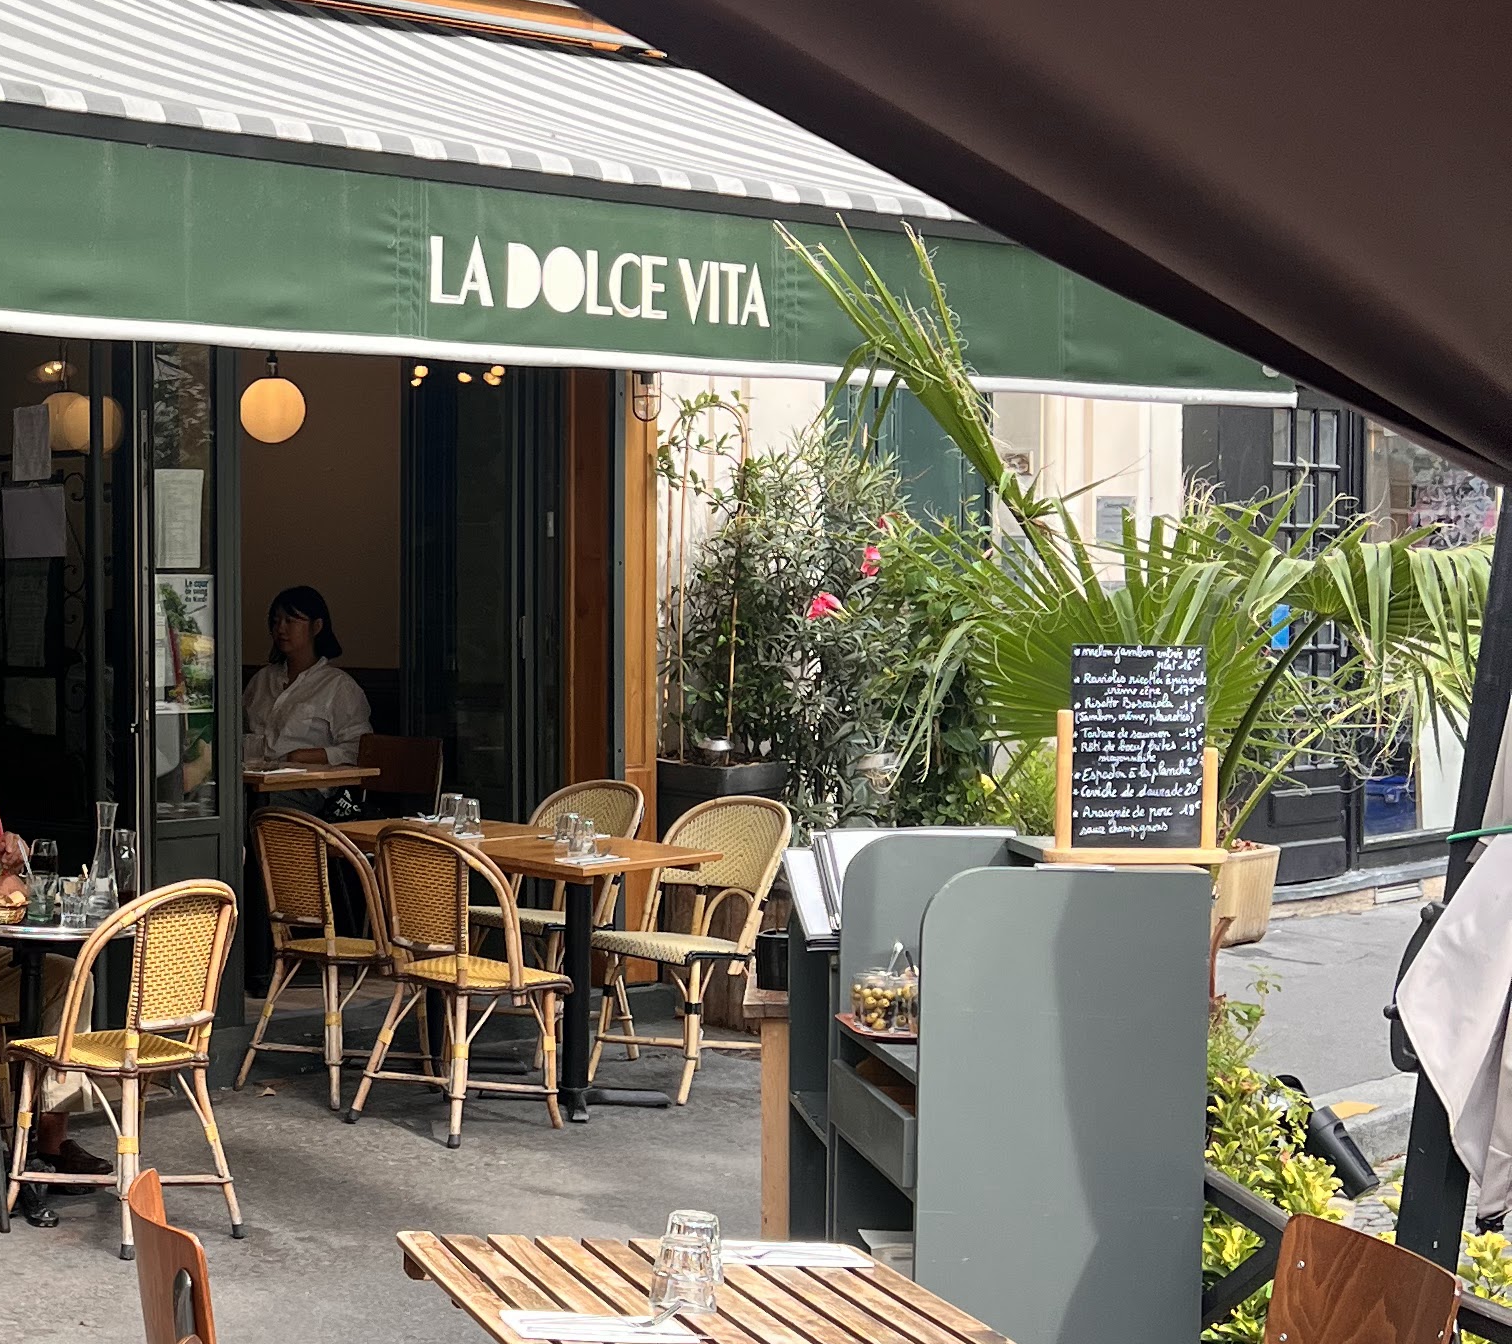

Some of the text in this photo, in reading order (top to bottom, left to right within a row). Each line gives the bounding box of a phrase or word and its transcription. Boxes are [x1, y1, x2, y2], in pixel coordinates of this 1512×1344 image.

[430, 235, 770, 327] LA DOLCE VITA
[1081, 644, 1113, 658] melon
[1113, 645, 1155, 664] jambon
[1153, 659, 1178, 676] plat
[1084, 696, 1120, 709] Risotto
[1080, 726, 1116, 739] Tartare
[1117, 726, 1129, 739] de
[1129, 729, 1171, 739] saumon
[1101, 739, 1116, 752] de
[1081, 763, 1127, 786] Espadon
[1138, 762, 1151, 778] la
[1080, 781, 1118, 798] Ceviche
[1120, 782, 1135, 798] de
[1131, 804, 1146, 819] de
[1148, 806, 1174, 823] porc
